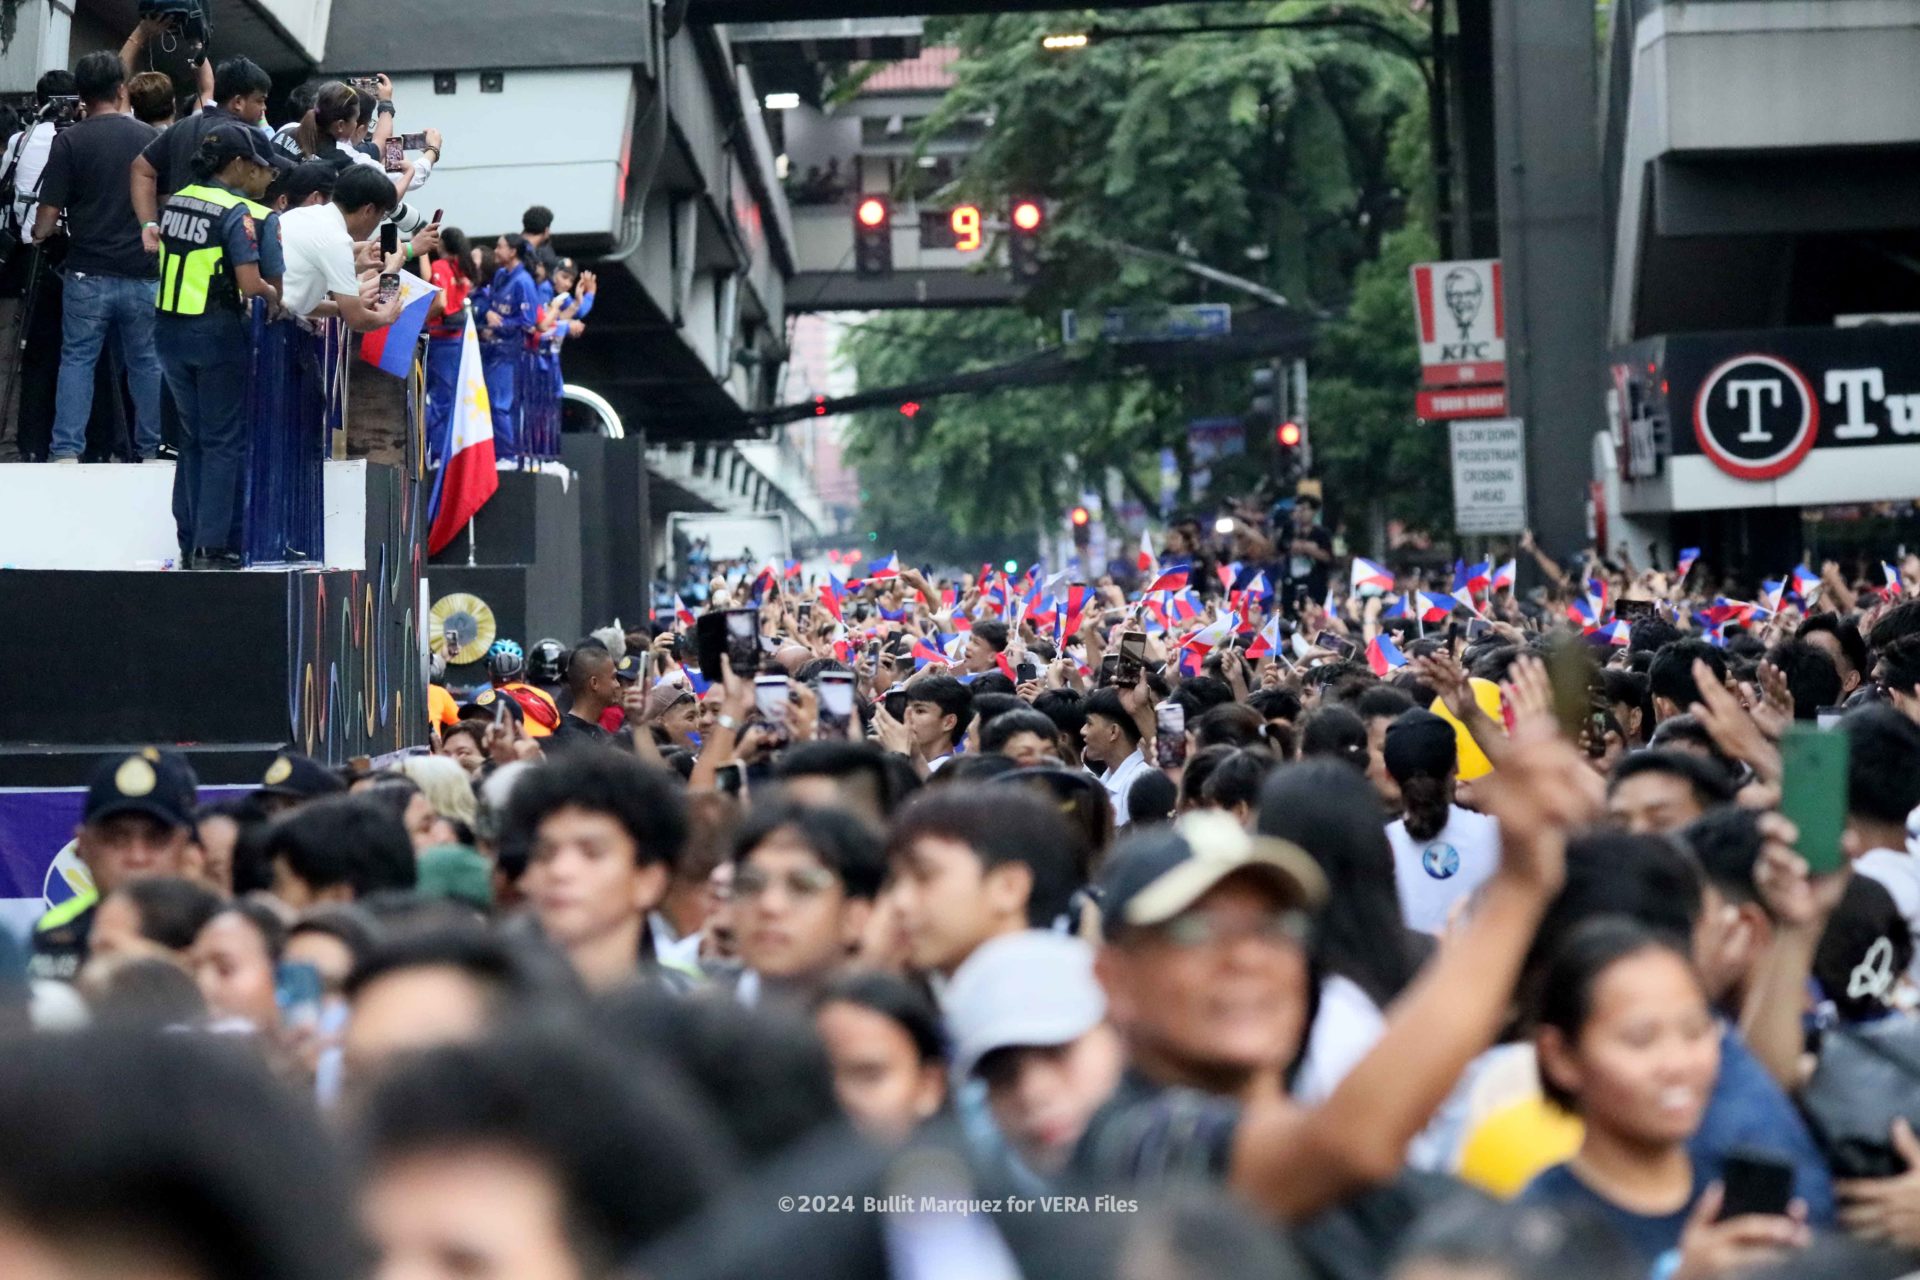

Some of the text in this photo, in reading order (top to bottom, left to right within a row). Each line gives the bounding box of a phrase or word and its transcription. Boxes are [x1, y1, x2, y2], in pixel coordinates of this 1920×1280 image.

[160, 210, 210, 244] PULIS
[952, 205, 980, 251] 9
[1441, 342, 1489, 359] KFC
[1727, 379, 1782, 442] T
[1457, 427, 1517, 442] SLOW DOWN
[1457, 448, 1519, 462] PEDESTRIAN
[1463, 468, 1514, 482] CROSSING
[1472, 488, 1506, 502] AHEAD
